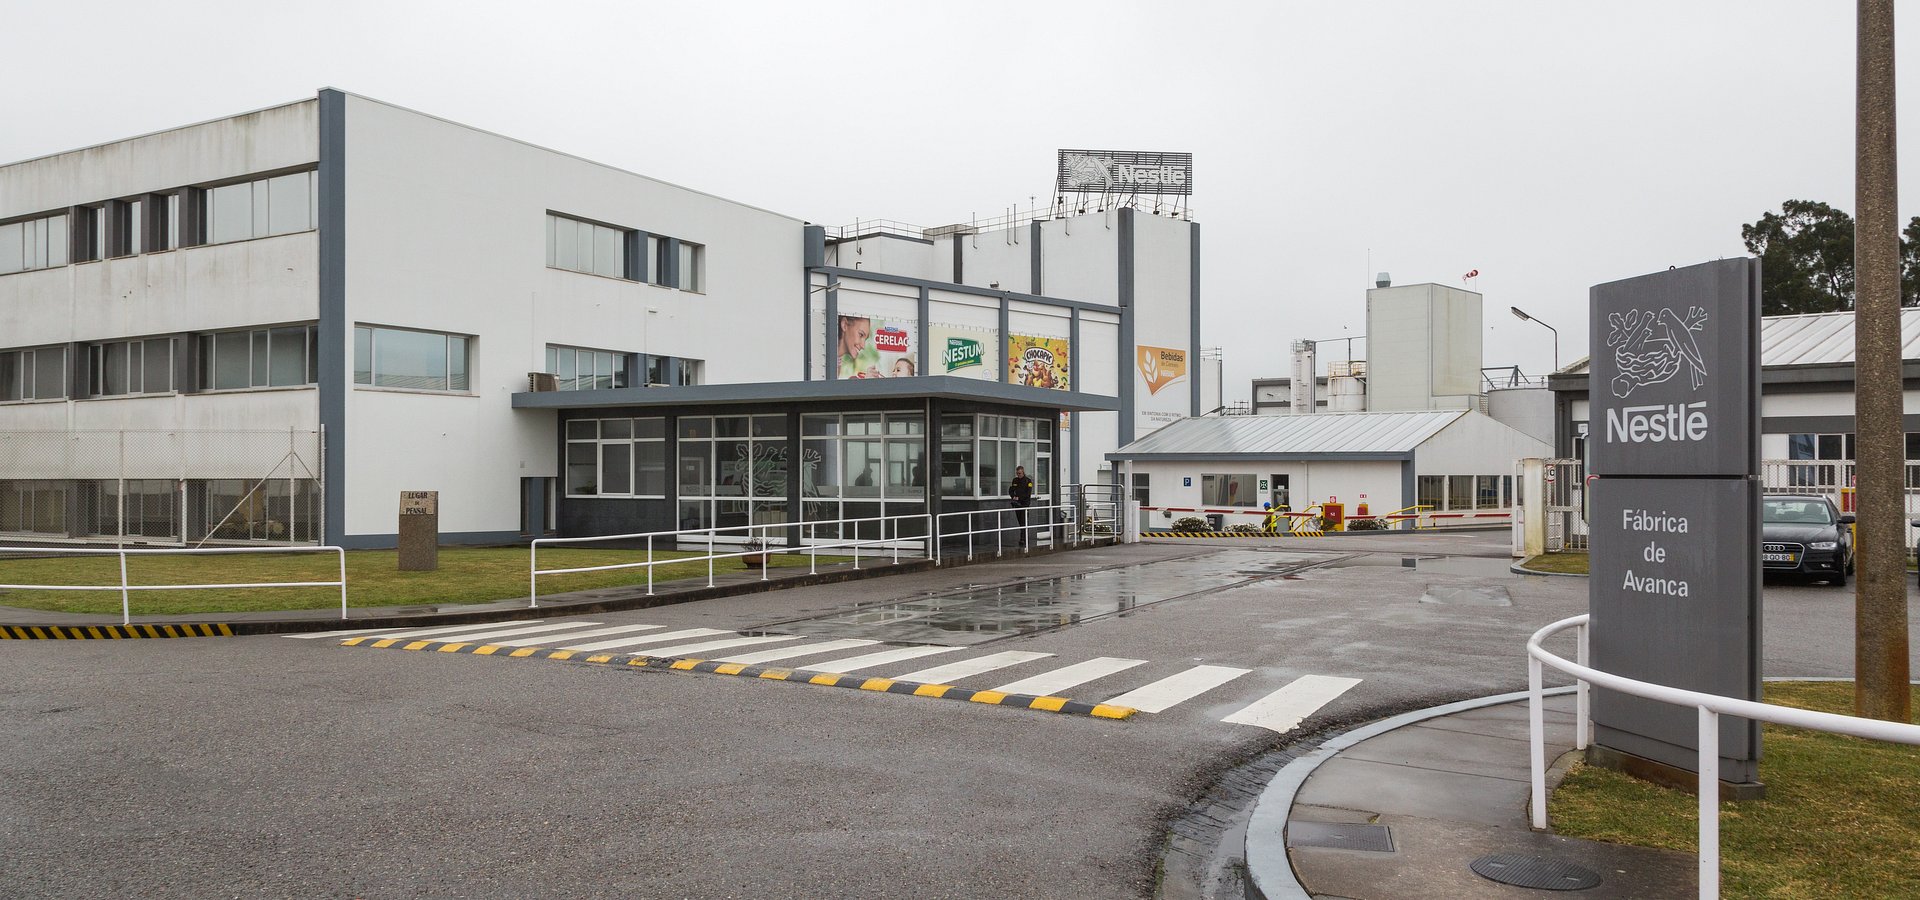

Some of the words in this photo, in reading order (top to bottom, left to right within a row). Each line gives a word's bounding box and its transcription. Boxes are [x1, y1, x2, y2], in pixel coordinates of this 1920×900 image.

[873, 334, 909, 347] CERELAC
[942, 343, 984, 366] NESTUM
[1026, 349, 1053, 363] CHOCAPIC
[1160, 351, 1184, 362] Bebidas
[1606, 401, 1709, 443] Nestlé
[1622, 509, 1688, 533] Fábrica
[1643, 541, 1666, 563] de
[1622, 569, 1689, 598] Avanca
